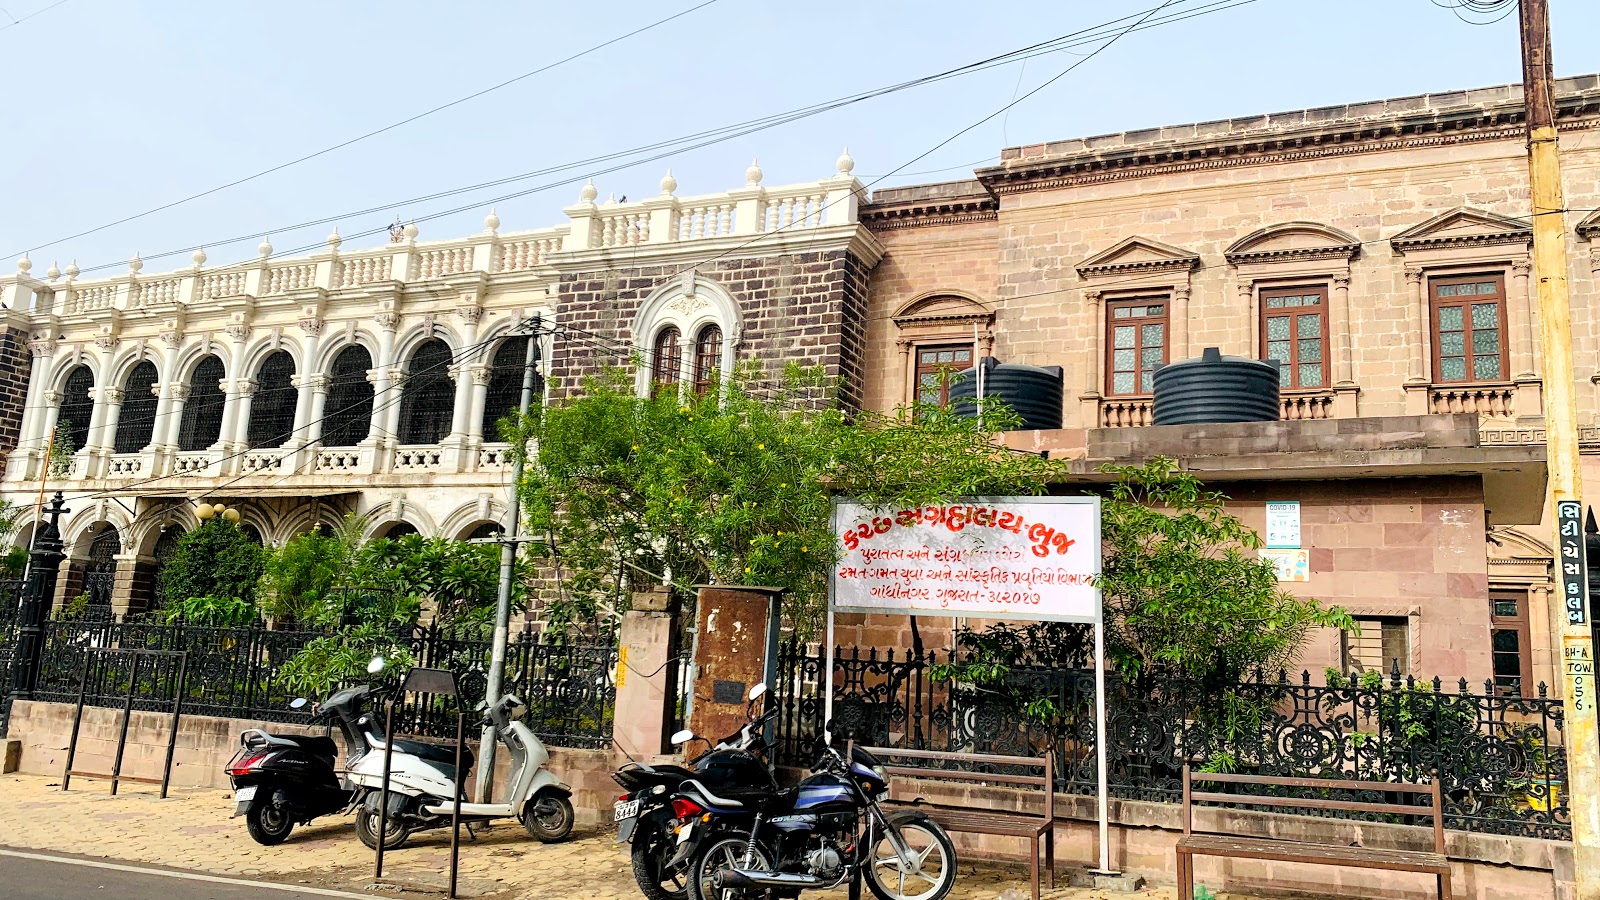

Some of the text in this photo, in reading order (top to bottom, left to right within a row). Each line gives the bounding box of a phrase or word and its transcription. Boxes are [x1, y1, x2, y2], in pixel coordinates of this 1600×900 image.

[906, 545, 931, 561] અને
[900, 568, 924, 586] યુવા
[926, 565, 952, 581] અને
